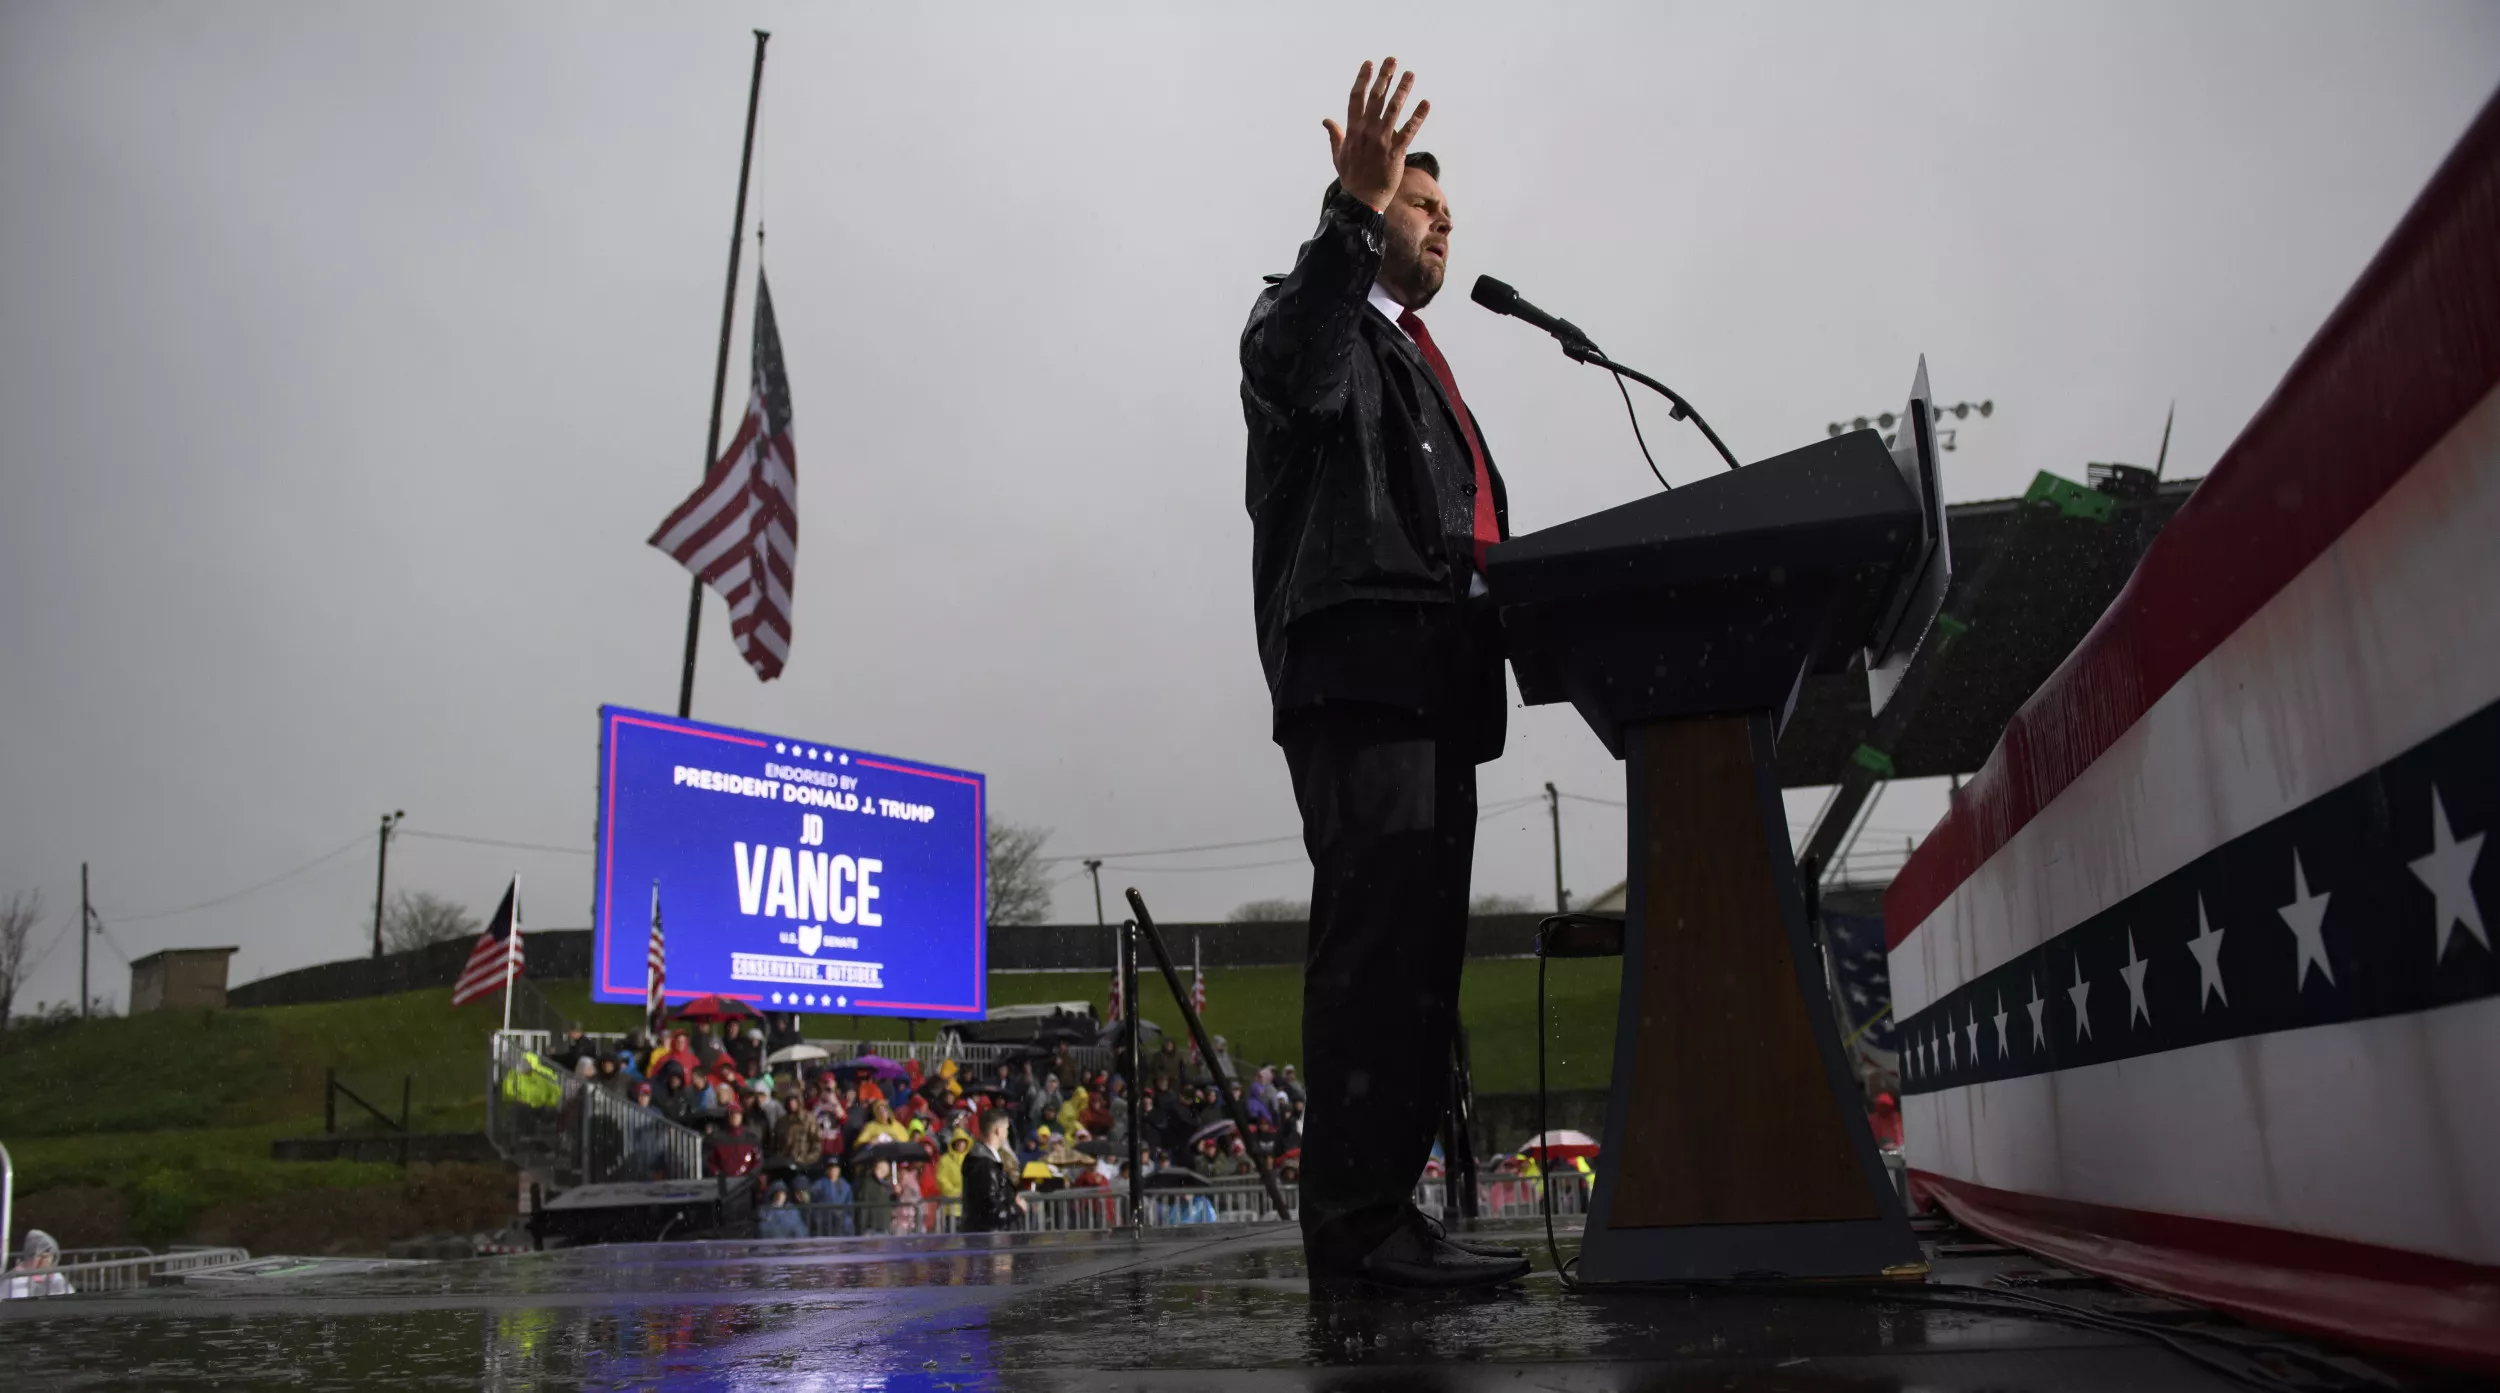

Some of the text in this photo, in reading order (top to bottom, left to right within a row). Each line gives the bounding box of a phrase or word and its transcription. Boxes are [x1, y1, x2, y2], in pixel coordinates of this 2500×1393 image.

[765, 763, 858, 790] ENDORSED BY
[674, 765, 934, 823] PRESIDENT DONALD J. TRUMP
[800, 813, 823, 846] JD
[734, 842, 882, 927] VANCE
[823, 935, 858, 948] SENATE
